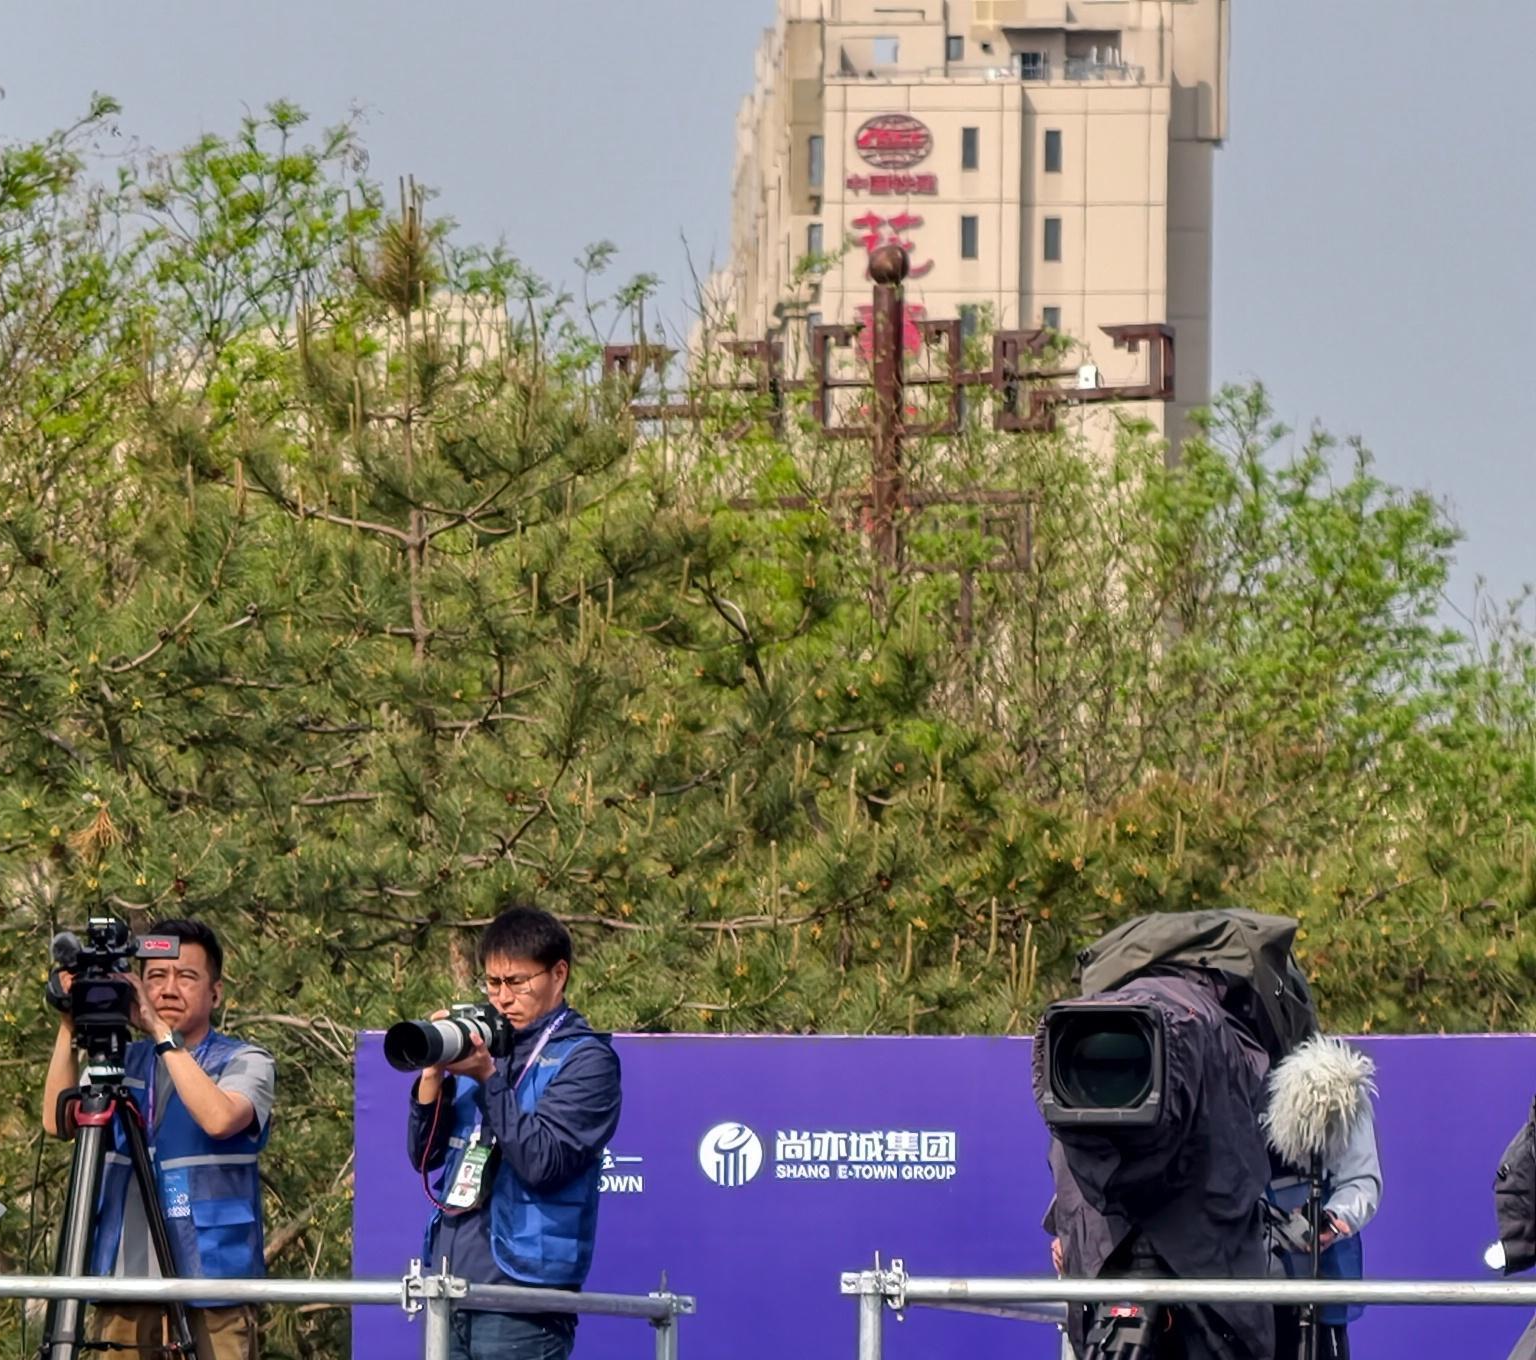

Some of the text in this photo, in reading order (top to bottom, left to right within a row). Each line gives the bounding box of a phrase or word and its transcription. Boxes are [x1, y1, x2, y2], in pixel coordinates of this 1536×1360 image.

[775, 1130, 957, 1162] 尚亦城集团
[775, 1164, 957, 1181] SHANG E-TOWN GROUP
